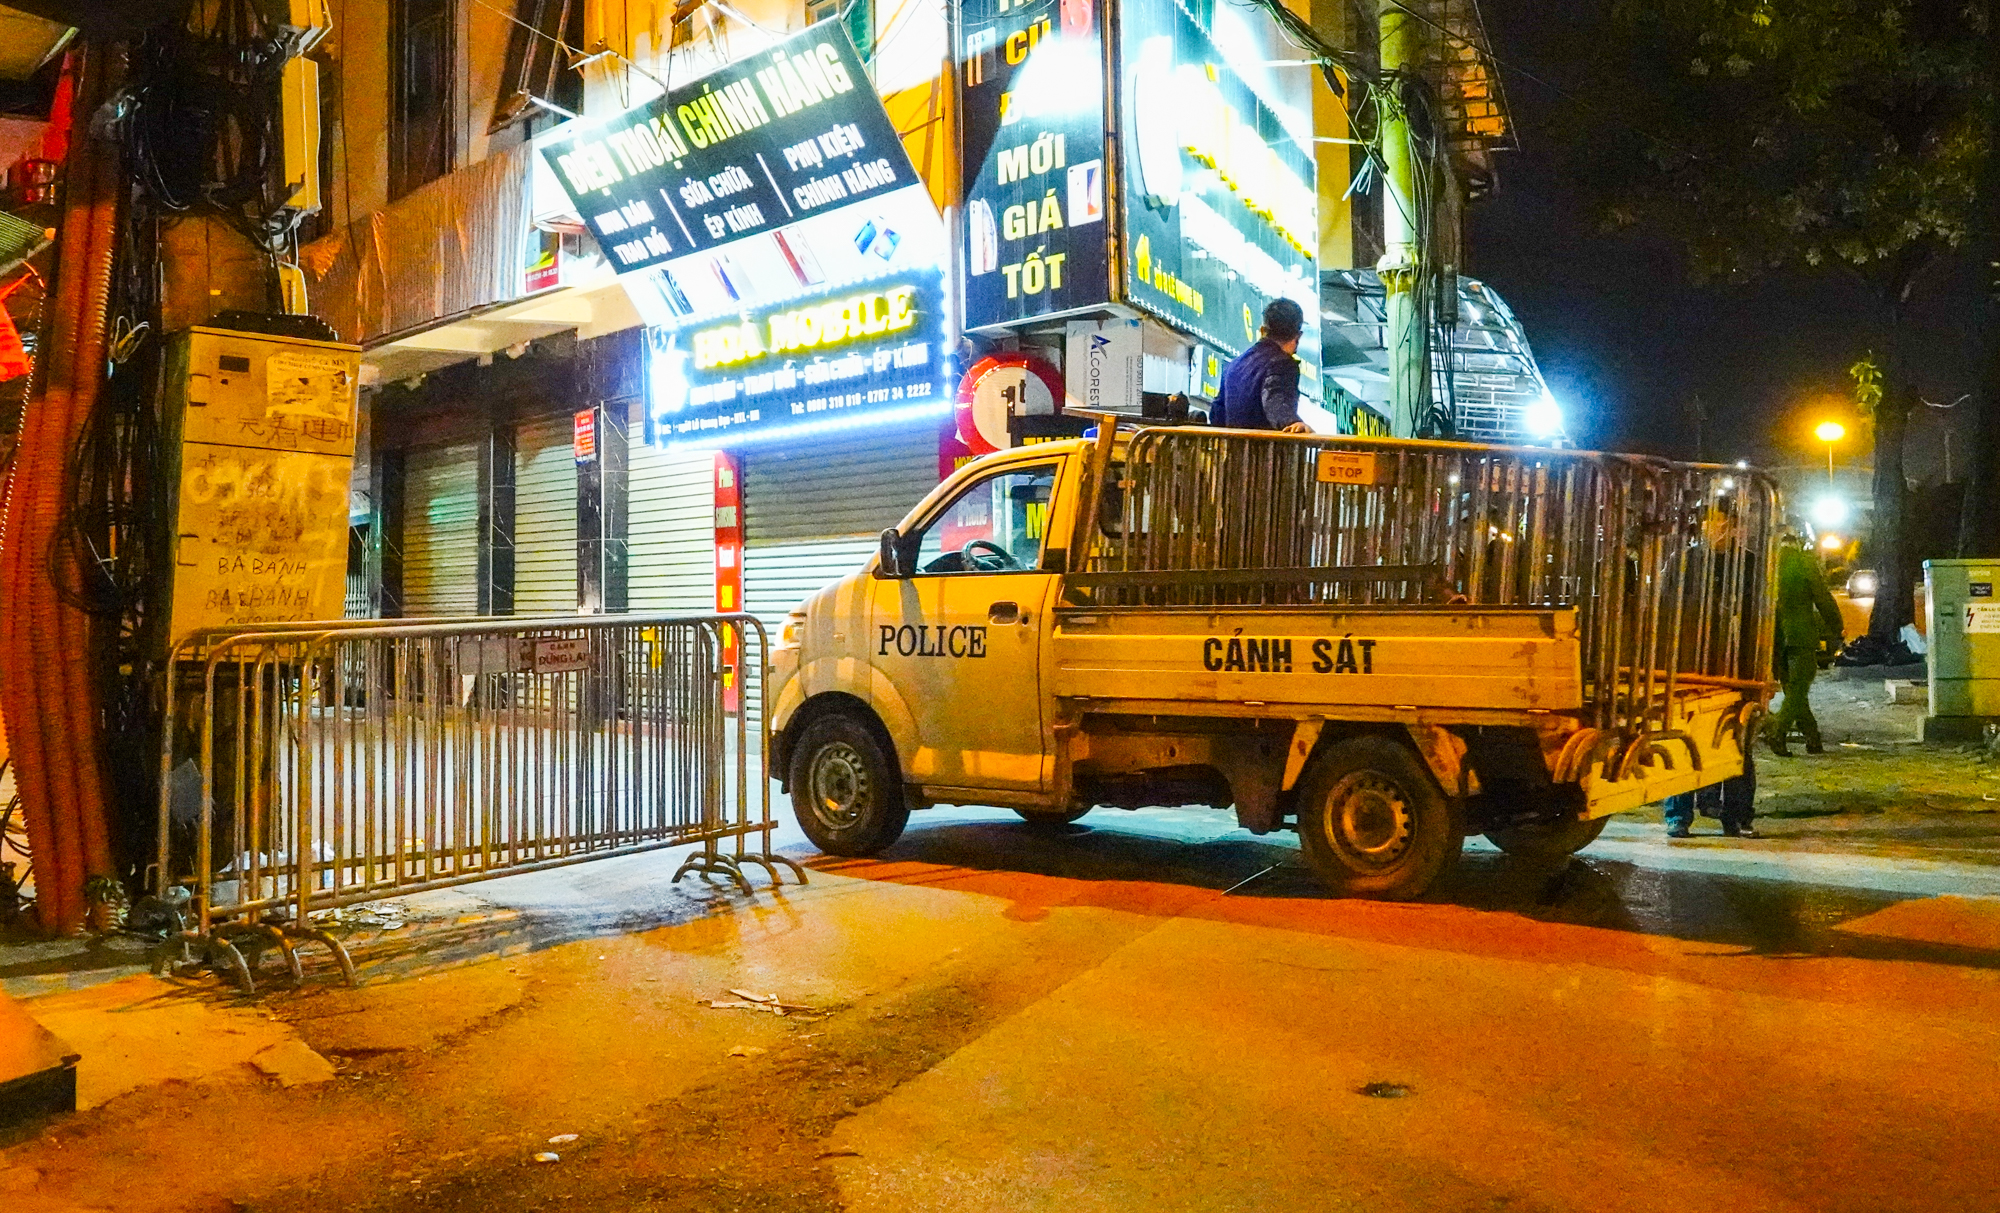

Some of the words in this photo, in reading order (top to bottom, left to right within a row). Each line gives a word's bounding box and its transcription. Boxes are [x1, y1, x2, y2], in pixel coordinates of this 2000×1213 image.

[557, 136, 623, 196] ĐIỆN
[606, 111, 688, 170] THOẠI
[677, 83, 770, 149] CHÍNH
[756, 43, 853, 118] HÃNG
[782, 138, 824, 172] PHỤ
[817, 123, 865, 158] KIỆN
[997, 131, 1065, 185] MỚI
[679, 177, 715, 208] SỬA
[708, 165, 754, 199] CHỮA
[793, 177, 848, 210] CHÍNH
[842, 158, 896, 194] HÃNG
[703, 213, 726, 240] ÉP
[723, 202, 766, 234] KÍNH
[1003, 188, 1063, 241] GIÁ
[1002, 245, 1066, 299] TỐT
[768, 284, 915, 354] MOBILE
[1089, 333, 1111, 407] ALCOREST
[1329, 466, 1363, 478] STOP
[252, 557, 307, 575] BÁNH
[878, 624, 987, 658] POLICE
[1203, 627, 1292, 672] CẢNH
[1312, 633, 1376, 674] SÁT
